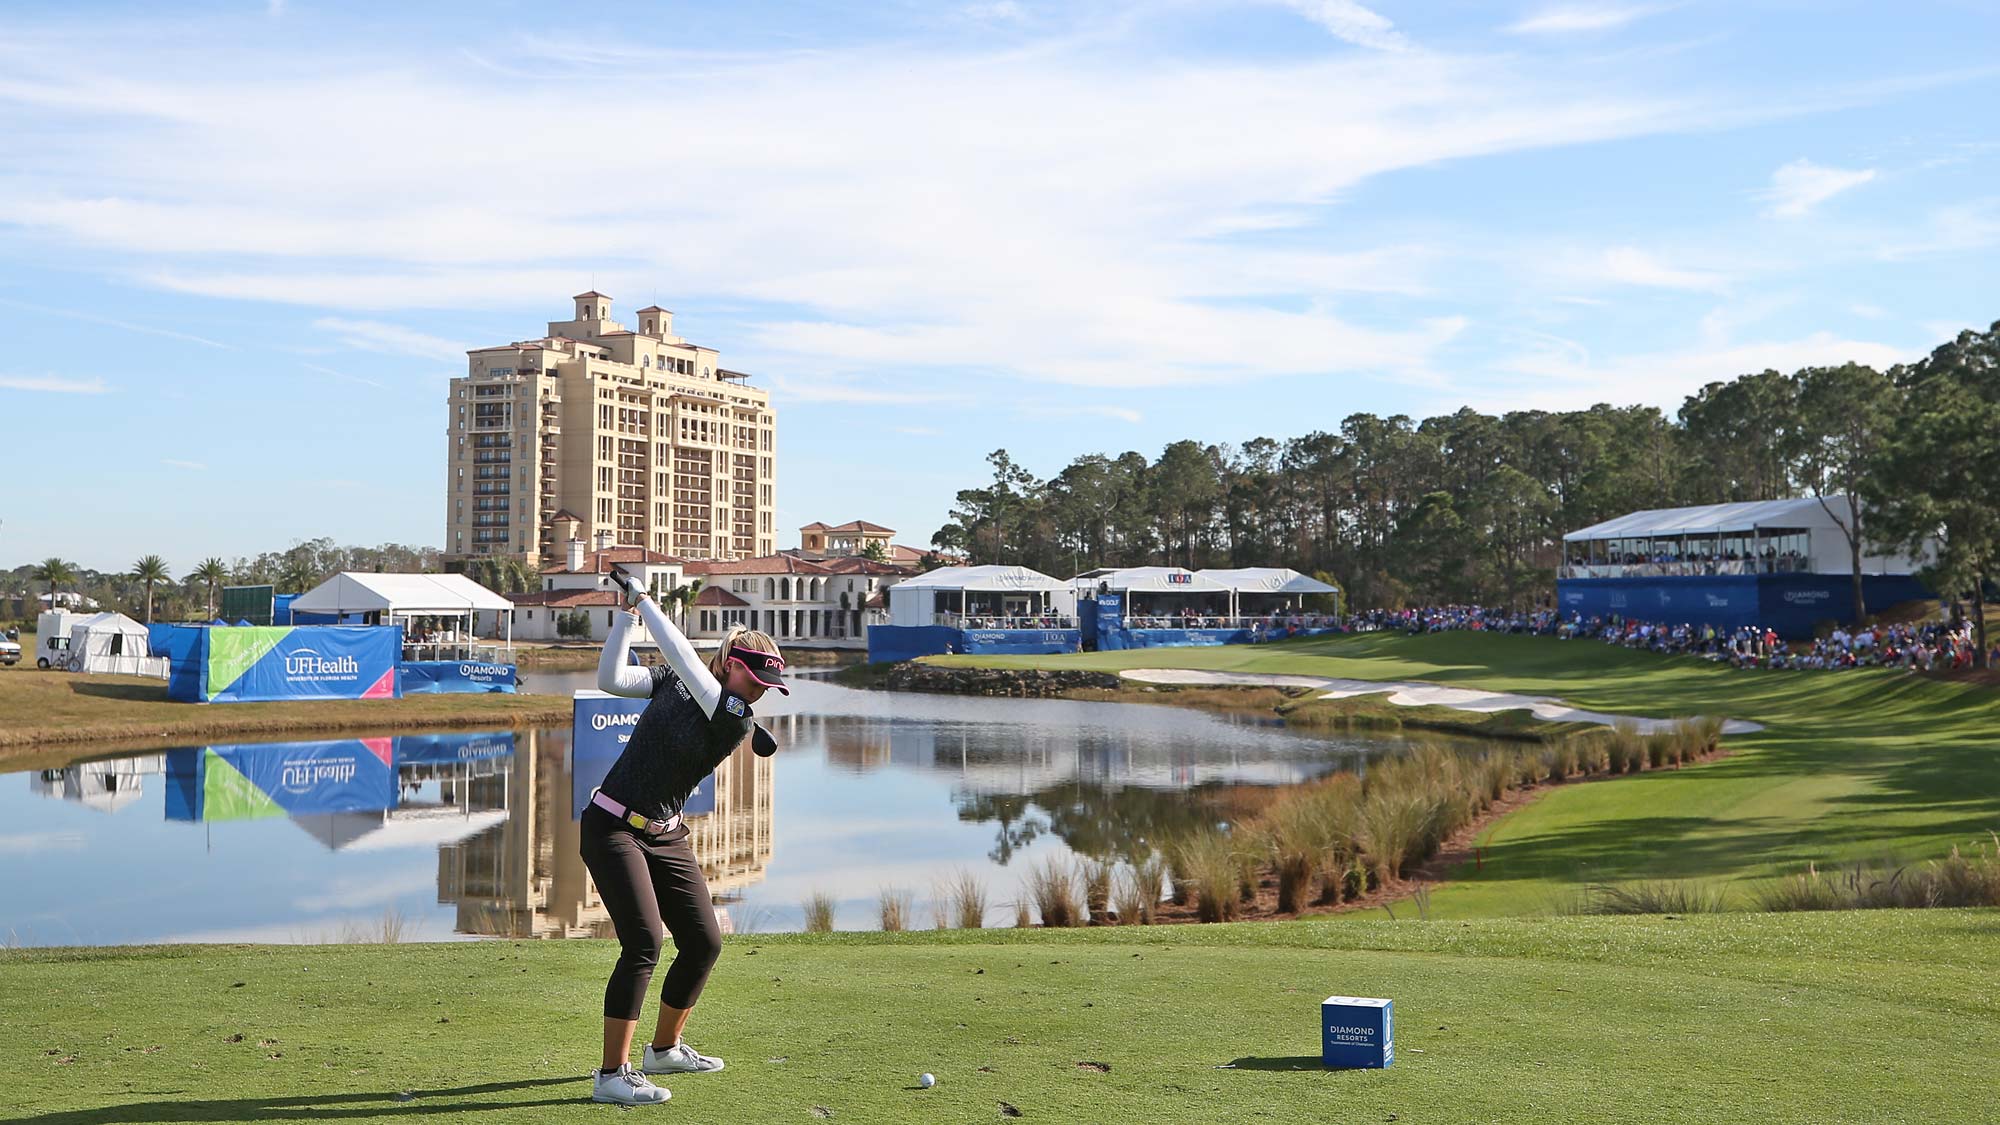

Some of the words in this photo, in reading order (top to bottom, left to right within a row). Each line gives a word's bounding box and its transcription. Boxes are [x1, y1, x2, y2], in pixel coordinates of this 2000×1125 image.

[972, 633, 1006, 641] DIAMOND
[285, 655, 358, 675] UFHealth
[460, 663, 509, 677] DIAMOND
[470, 674, 492, 682] Resorts
[591, 713, 641, 731] DIAMO
[1330, 1026, 1375, 1036] DIAMOND
